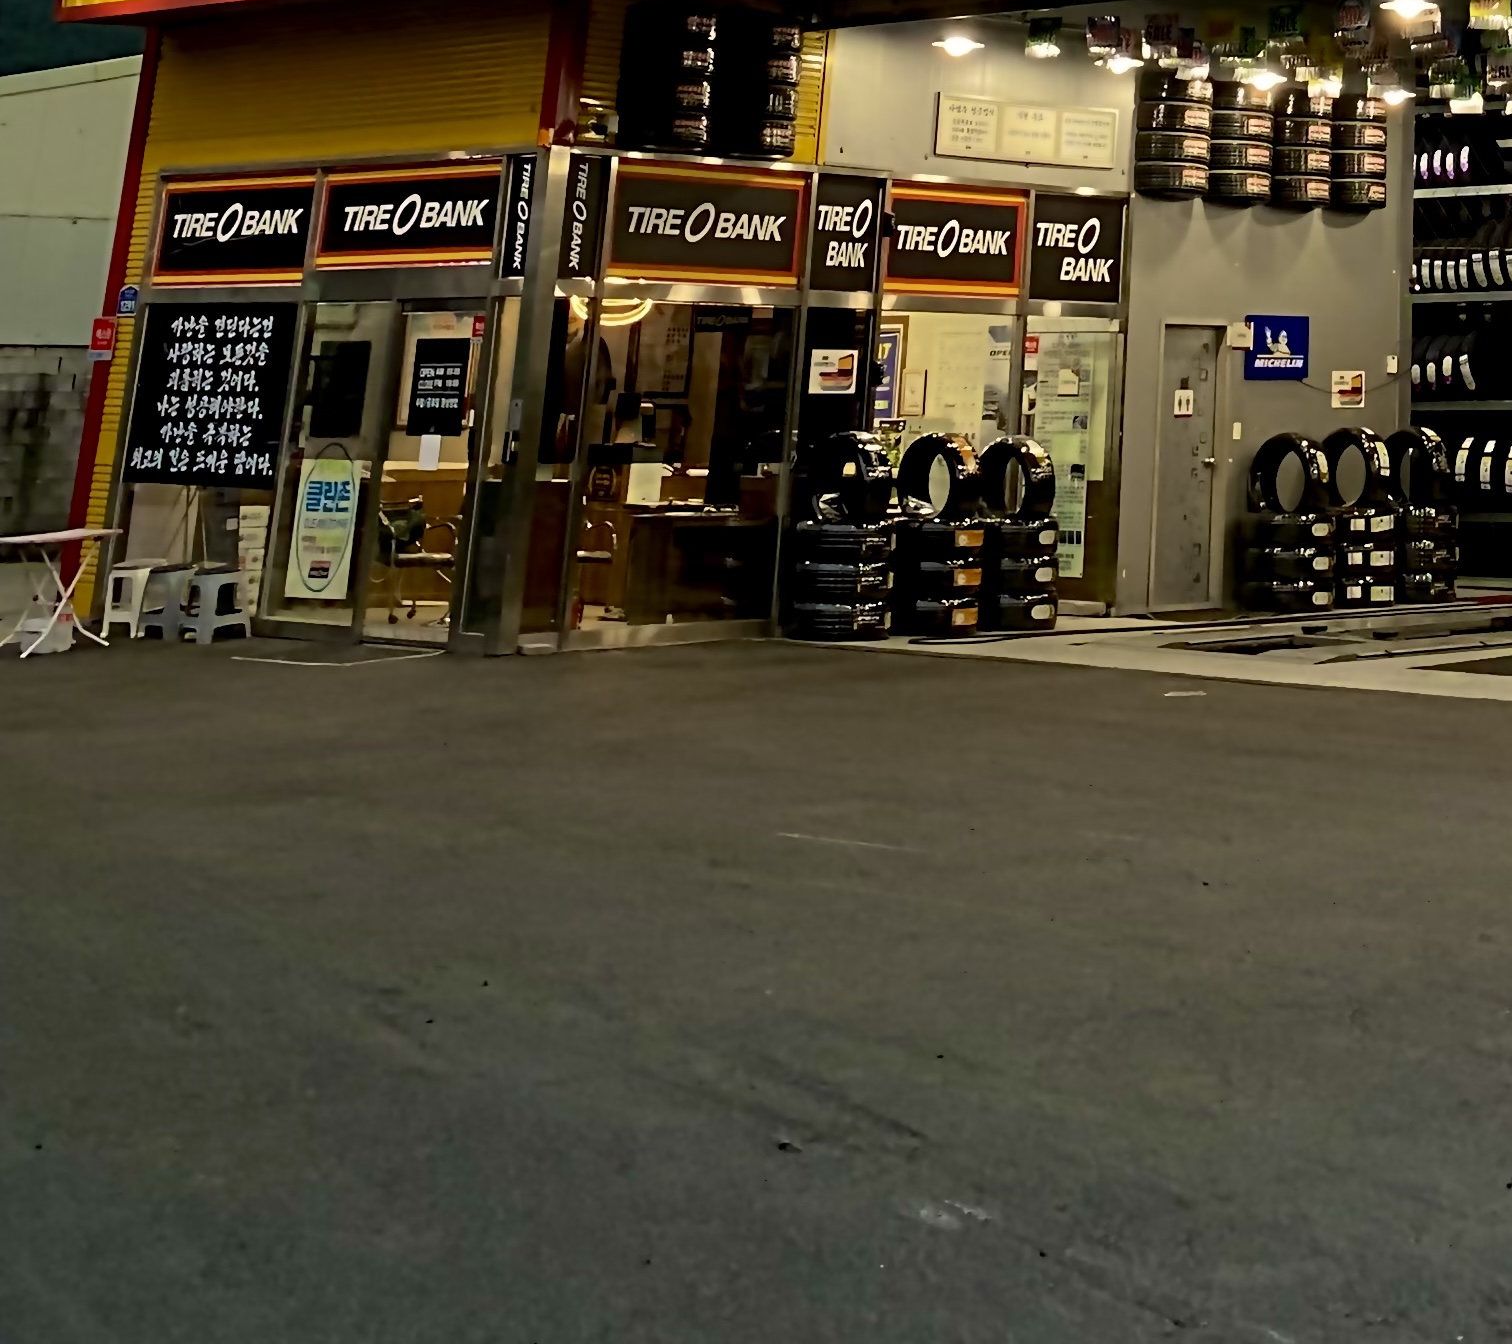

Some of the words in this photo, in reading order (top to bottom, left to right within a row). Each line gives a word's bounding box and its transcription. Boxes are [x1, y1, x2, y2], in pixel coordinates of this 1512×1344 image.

[825, 241, 868, 268] BANK
[1060, 257, 1115, 283] BANK
[1254, 358, 1304, 368] MICHELIN
[306, 480, 351, 513] 클린존
